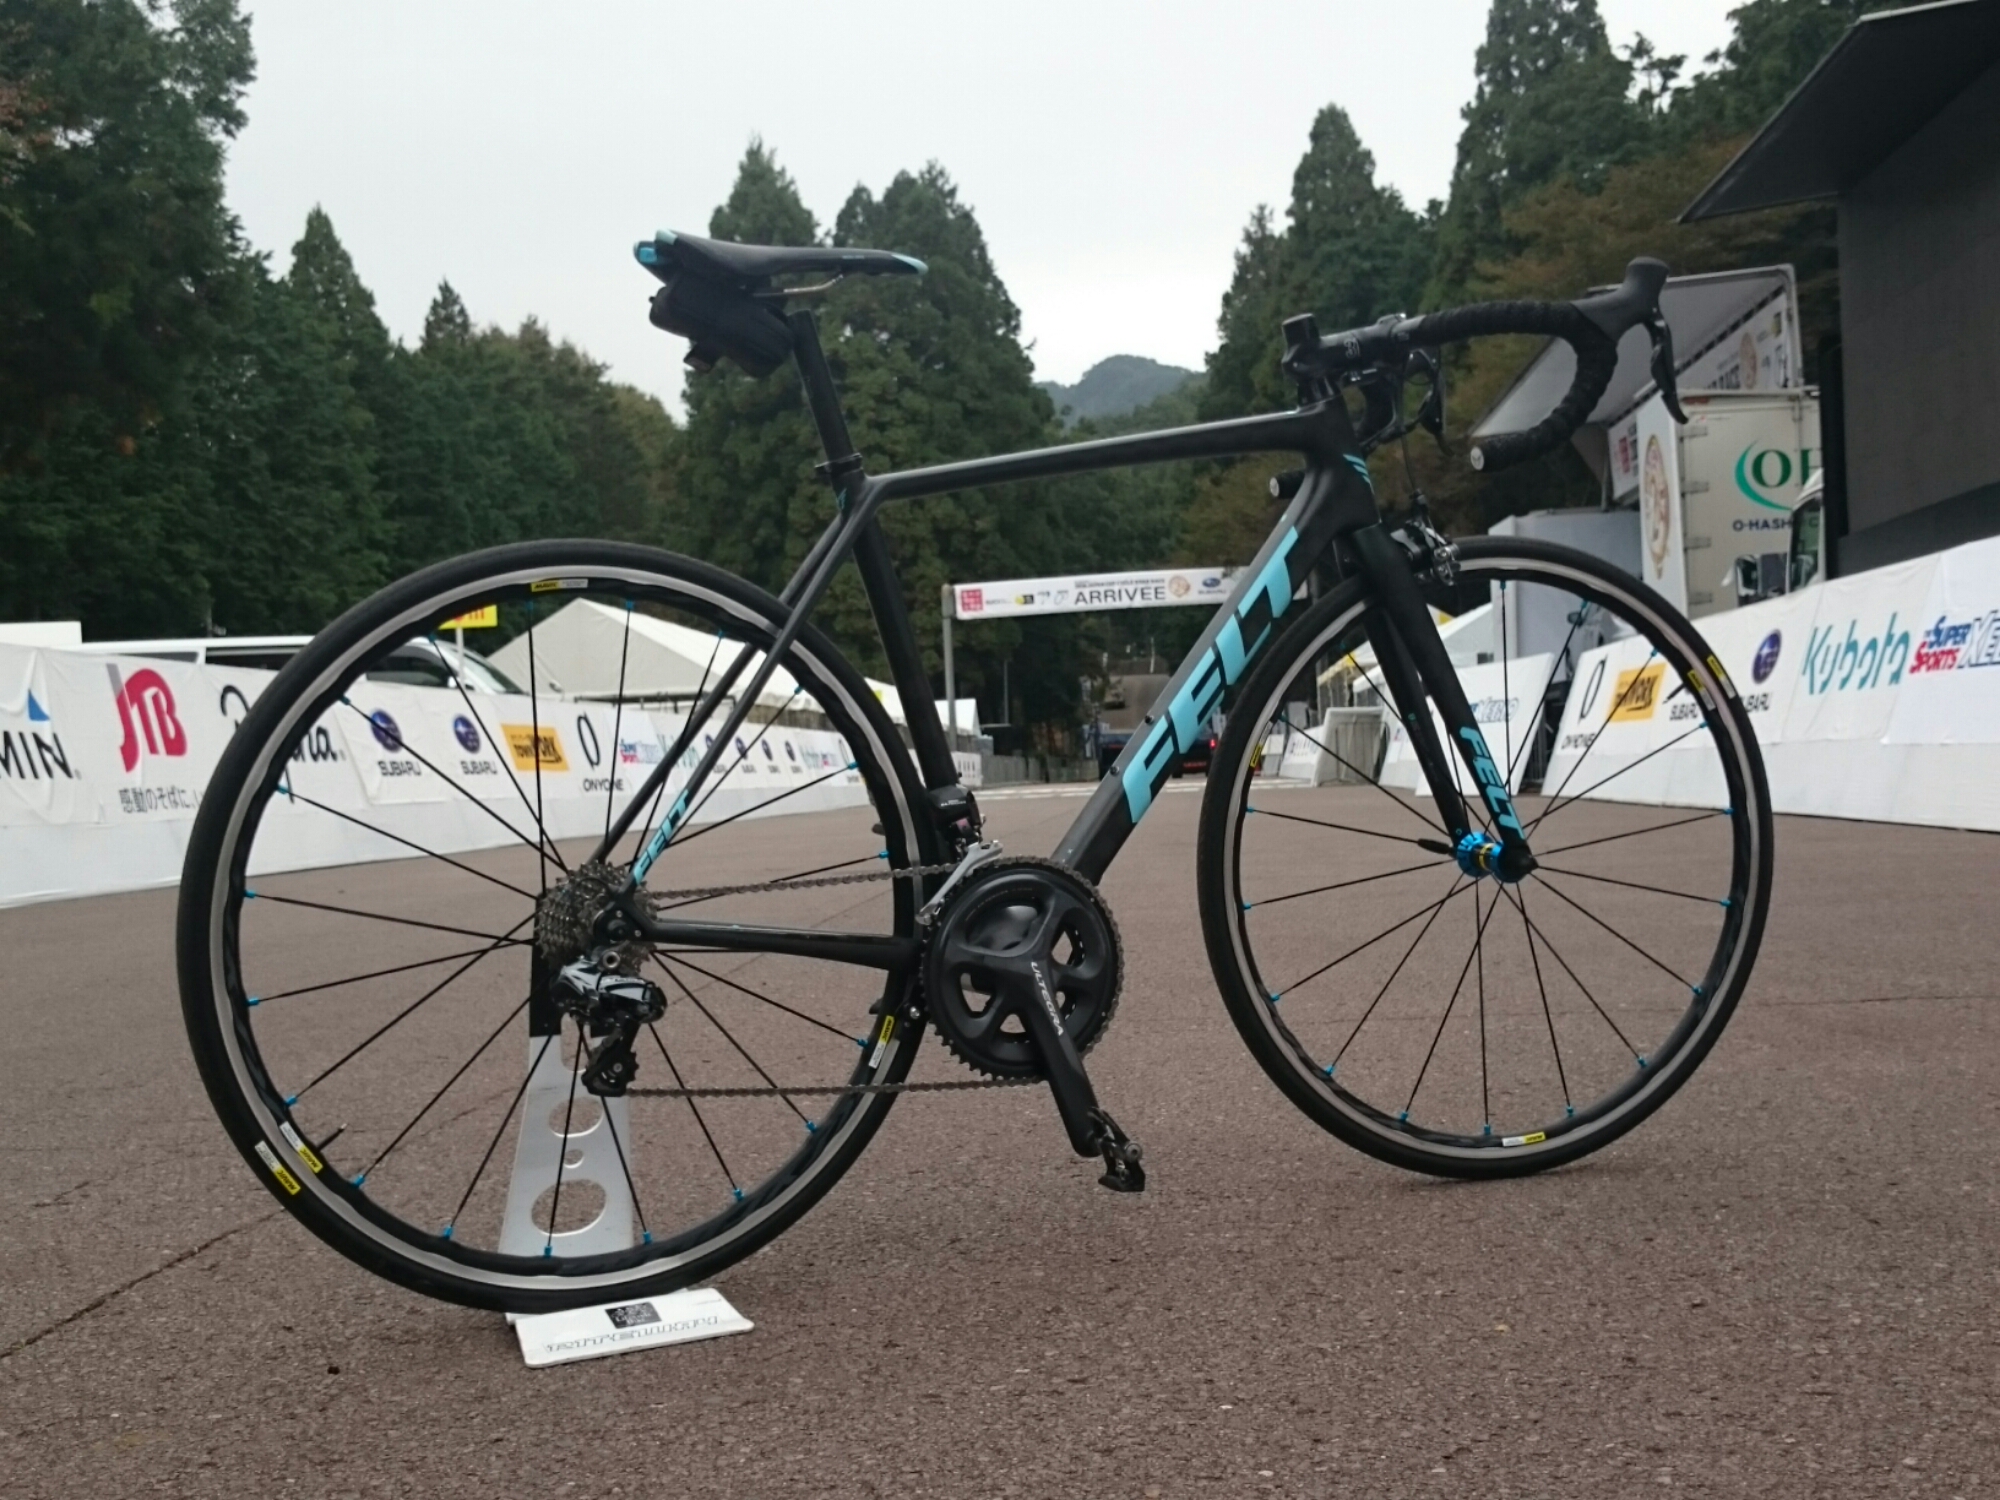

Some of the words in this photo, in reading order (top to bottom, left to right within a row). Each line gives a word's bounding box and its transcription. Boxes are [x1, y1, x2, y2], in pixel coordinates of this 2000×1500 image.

[1074, 585, 1166, 605] ARRIVEE
[1123, 526, 1298, 823] FELT
[1802, 612, 1910, 695] Kubota
[1957, 609, 2000, 669] XE
[106, 662, 188, 773] JTB
[378, 761, 421, 777] SUBARU
[1460, 726, 1525, 839] FELT
[634, 788, 689, 885] FELT
[1031, 961, 1064, 1036] ULTEGRA
